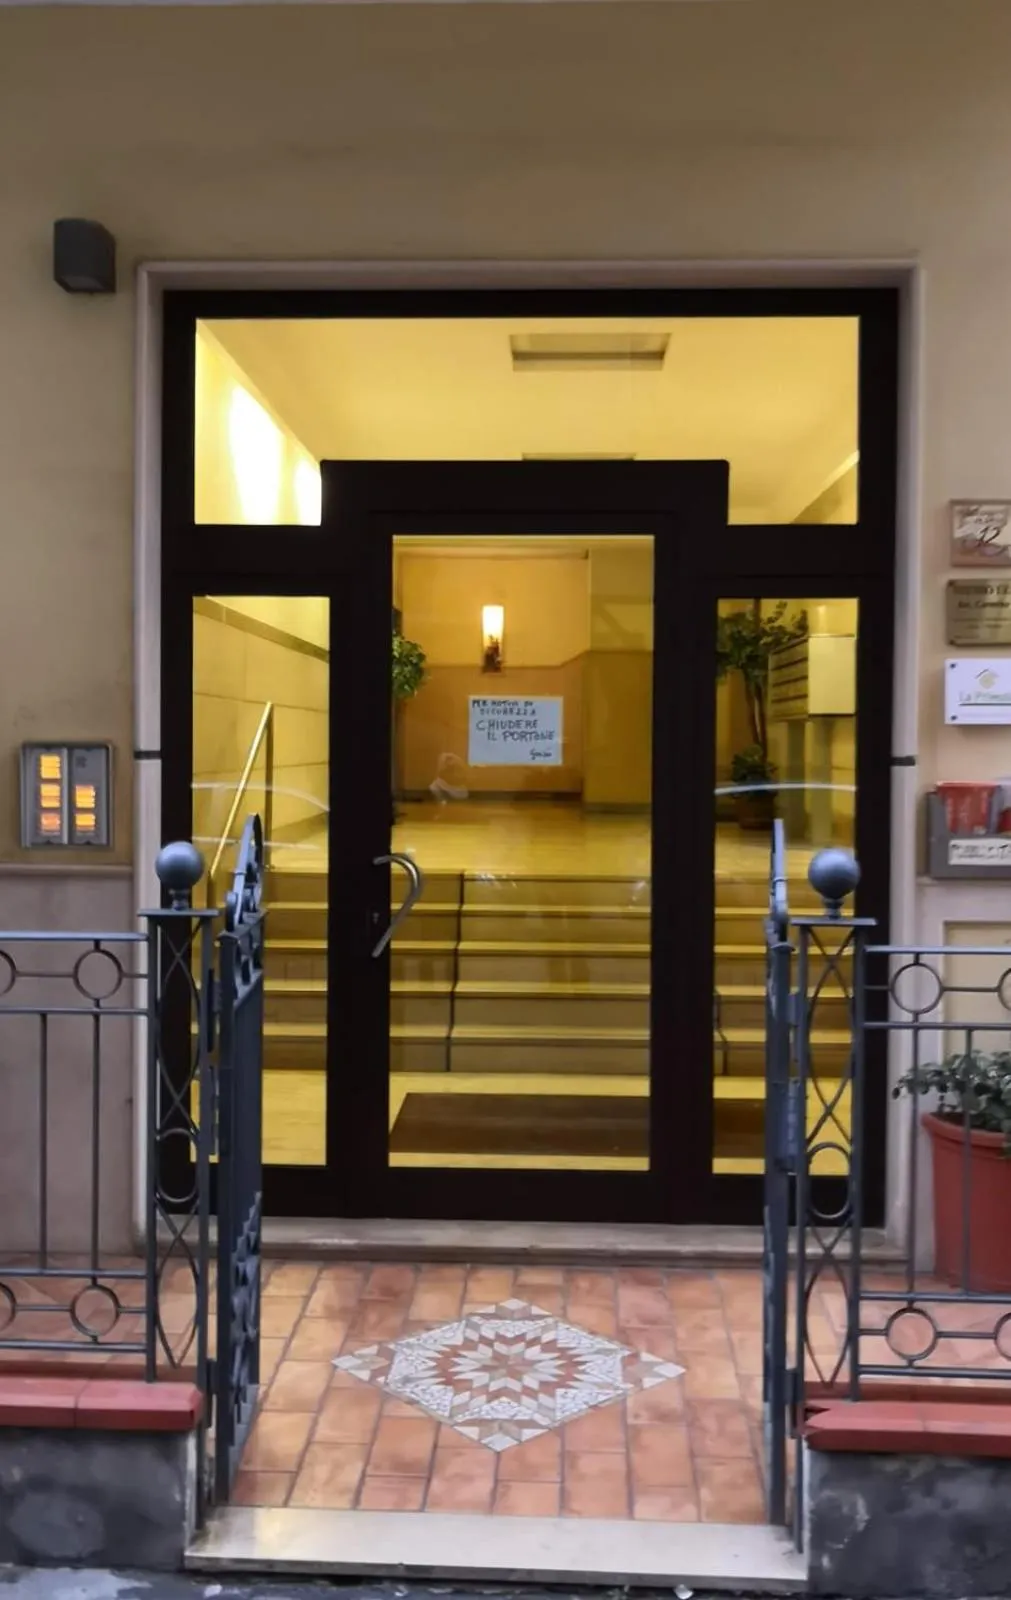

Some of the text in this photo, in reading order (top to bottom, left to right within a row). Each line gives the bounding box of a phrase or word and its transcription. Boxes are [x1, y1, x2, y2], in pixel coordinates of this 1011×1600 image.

[479, 708, 536, 716] SICUREZZA
[476, 719, 539, 731] CHIUDERE
[487, 731, 497, 741] IL
